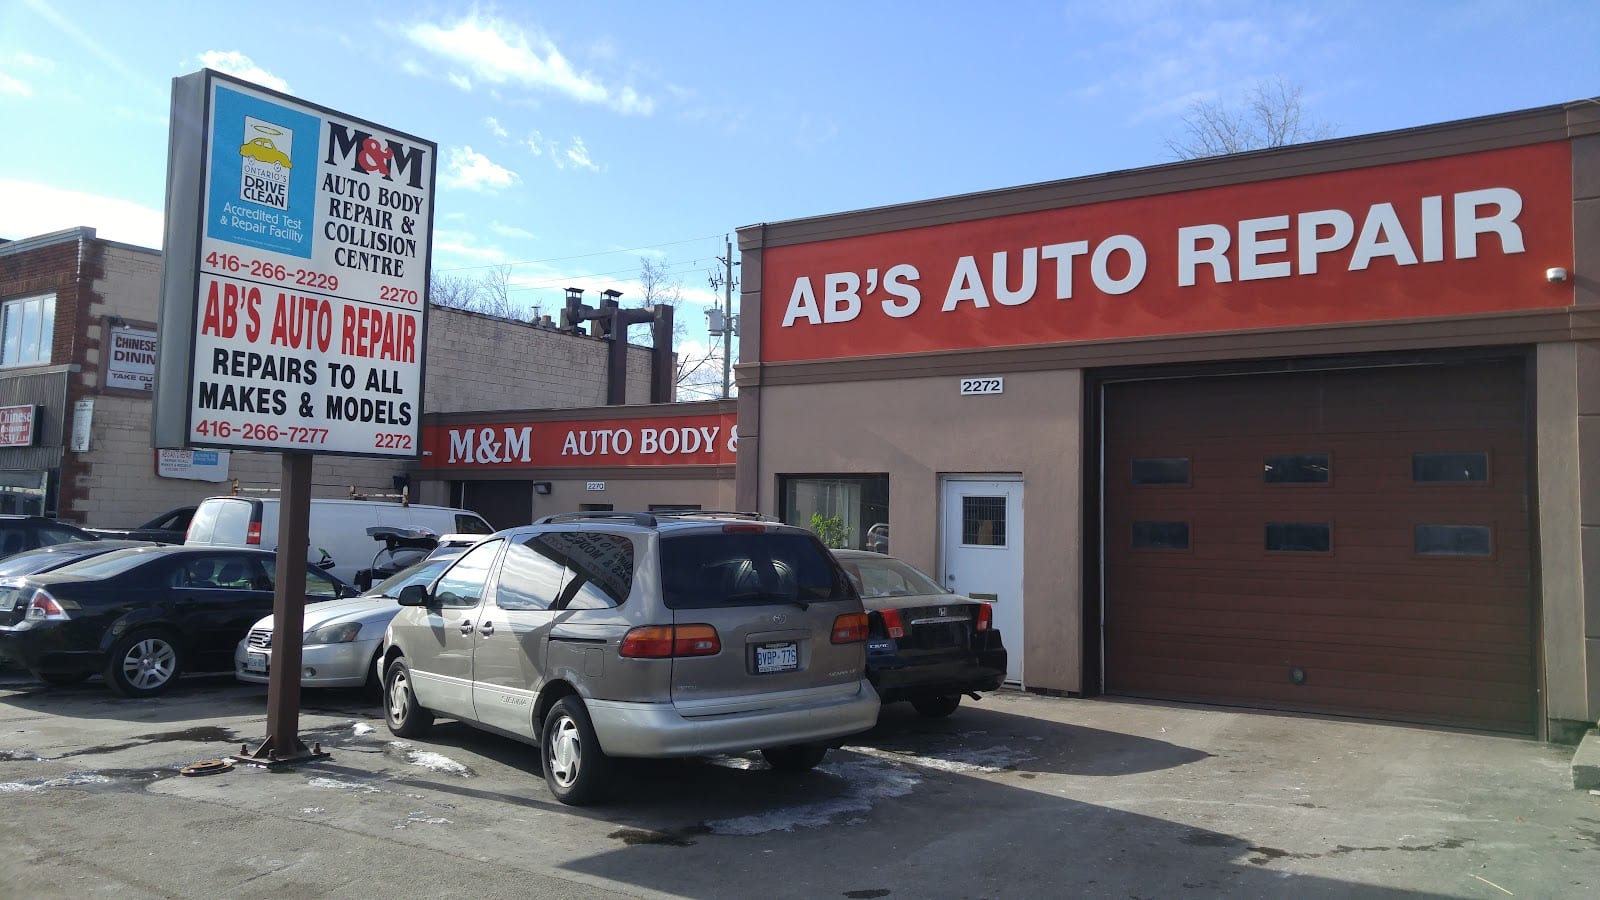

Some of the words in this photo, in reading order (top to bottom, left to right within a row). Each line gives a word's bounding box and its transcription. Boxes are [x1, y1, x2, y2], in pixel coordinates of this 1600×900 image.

[324, 121, 426, 189] M&M
[244, 165, 287, 183] ONTARIO'S
[244, 175, 286, 197] DRIVE
[243, 187, 285, 208] CLEAN
[322, 172, 370, 201] AUTO
[378, 187, 424, 214] BODY
[220, 215, 228, 226] &
[231, 216, 266, 234] Repair
[269, 226, 304, 243] Facility
[223, 202, 279, 225] Accredited
[282, 215, 302, 230] Test
[329, 197, 393, 230] REPAIR
[401, 216, 415, 235] &
[324, 222, 416, 258] COLLISION
[205, 251, 338, 291] 416-266-2229
[334, 248, 404, 277] CENTRE
[781, 262, 922, 328] AB'S
[941, 234, 1148, 313] AUTO
[1177, 186, 1527, 287] REPAIR
[380, 286, 418, 305] 2270
[201, 280, 262, 343] AB'S
[271, 293, 333, 353] AUTO
[341, 304, 416, 363] REPAIR
[114, 350, 156, 365] DININ
[115, 336, 156, 352] CHINESE
[212, 348, 317, 385] REPAIRS
[328, 363, 356, 390] TO
[365, 368, 403, 394] ALL
[962, 379, 1001, 394] 2272
[199, 381, 287, 416] MAKES
[298, 392, 314, 418] &
[326, 395, 412, 426] MODELS
[196, 419, 329, 444] 416-266-7277
[375, 433, 412, 449] 2272
[448, 426, 533, 464] M&M
[561, 428, 633, 456] AUTO
[640, 426, 720, 455] BODY
[587, 482, 604, 490] 2270
